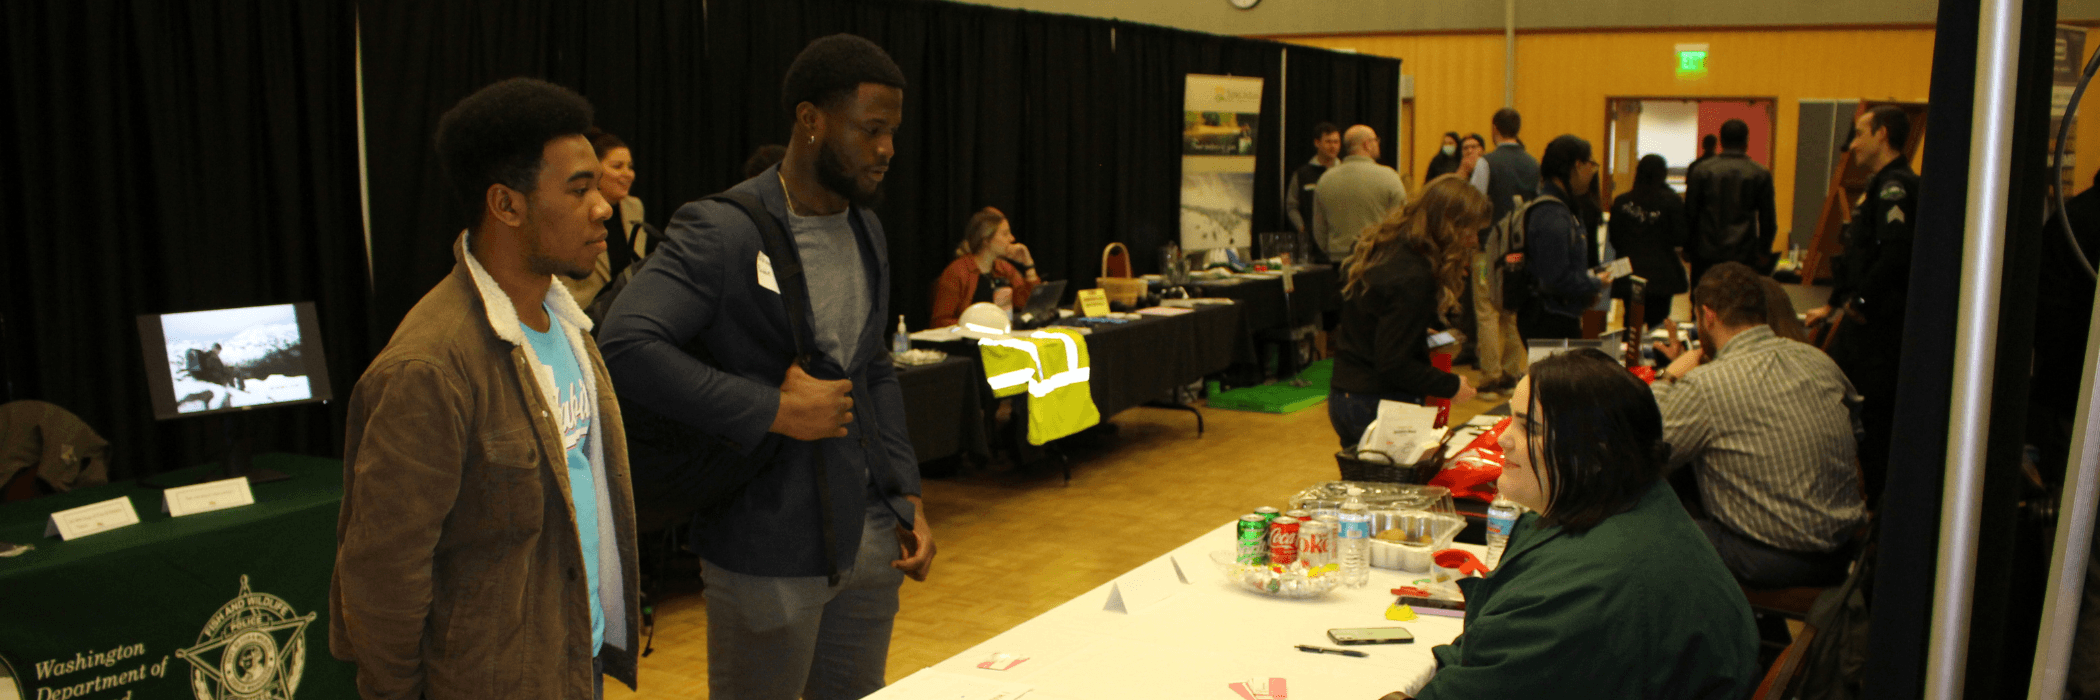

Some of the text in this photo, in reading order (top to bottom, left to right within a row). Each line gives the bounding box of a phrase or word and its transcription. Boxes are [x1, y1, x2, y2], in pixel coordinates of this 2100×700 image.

[224, 600, 245, 616] AND
[246, 597, 289, 616] WILDLIFE
[229, 616, 263, 632] POLICE
[35, 642, 145, 680] Washington
[36, 655, 169, 700] Department of
